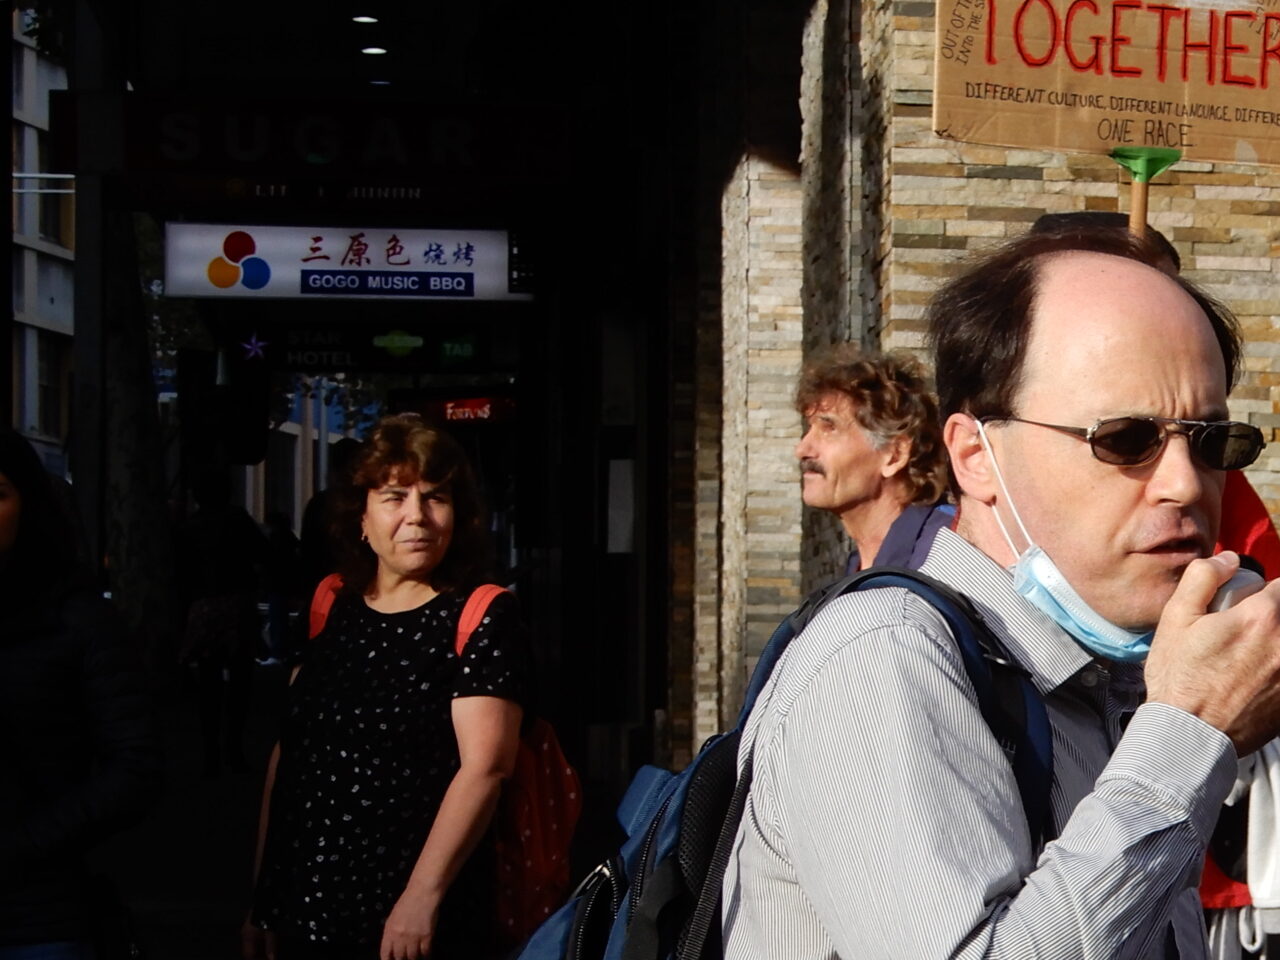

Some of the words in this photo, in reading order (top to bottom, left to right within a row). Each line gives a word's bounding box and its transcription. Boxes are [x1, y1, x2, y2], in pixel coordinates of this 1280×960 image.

[941, 29, 959, 59] OUT
[951, 8, 966, 29] OF
[955, 35, 975, 66] INTO
[967, 11, 984, 31] THE
[965, 82, 1046, 104] DIFFERENT
[1109, 96, 1172, 116] DIFFERENT
[158, 111, 476, 167] SUGAR
[1097, 117, 1135, 143] ONE
[301, 231, 411, 268] 三原色
[423, 242, 476, 268] 烧烤
[308, 273, 360, 289] GOGO
[367, 275, 420, 290] MUSIC
[429, 276, 466, 292] BBQ
